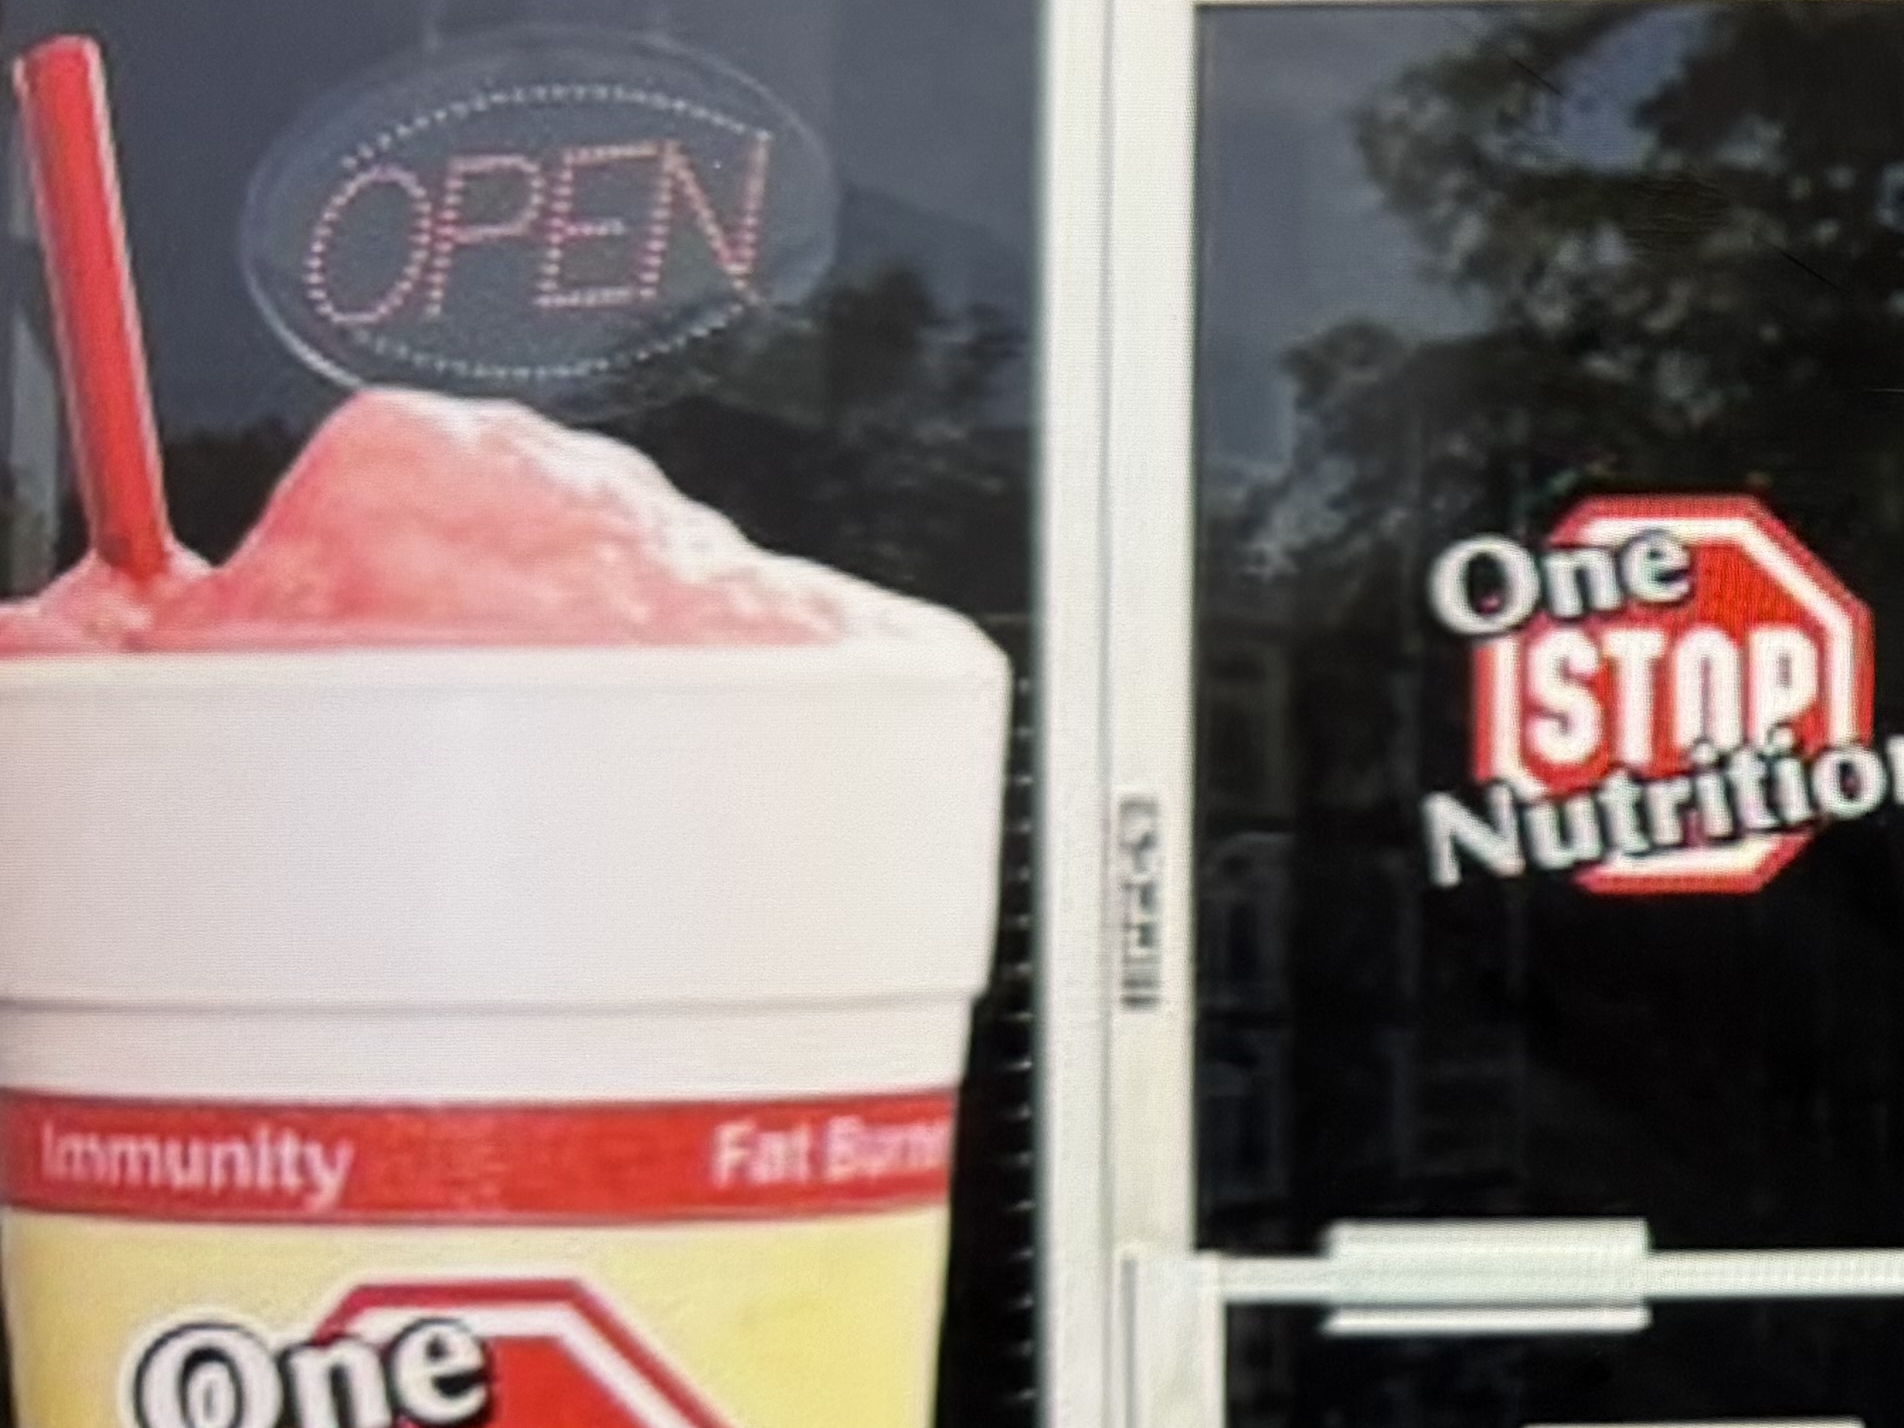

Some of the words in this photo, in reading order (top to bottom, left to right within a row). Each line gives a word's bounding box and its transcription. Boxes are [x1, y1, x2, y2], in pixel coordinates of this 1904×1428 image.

[304, 132, 772, 320] OPEN
[1427, 527, 1692, 637] One
[1523, 622, 1822, 770] STOP
[42, 1122, 355, 1212] Immunity
